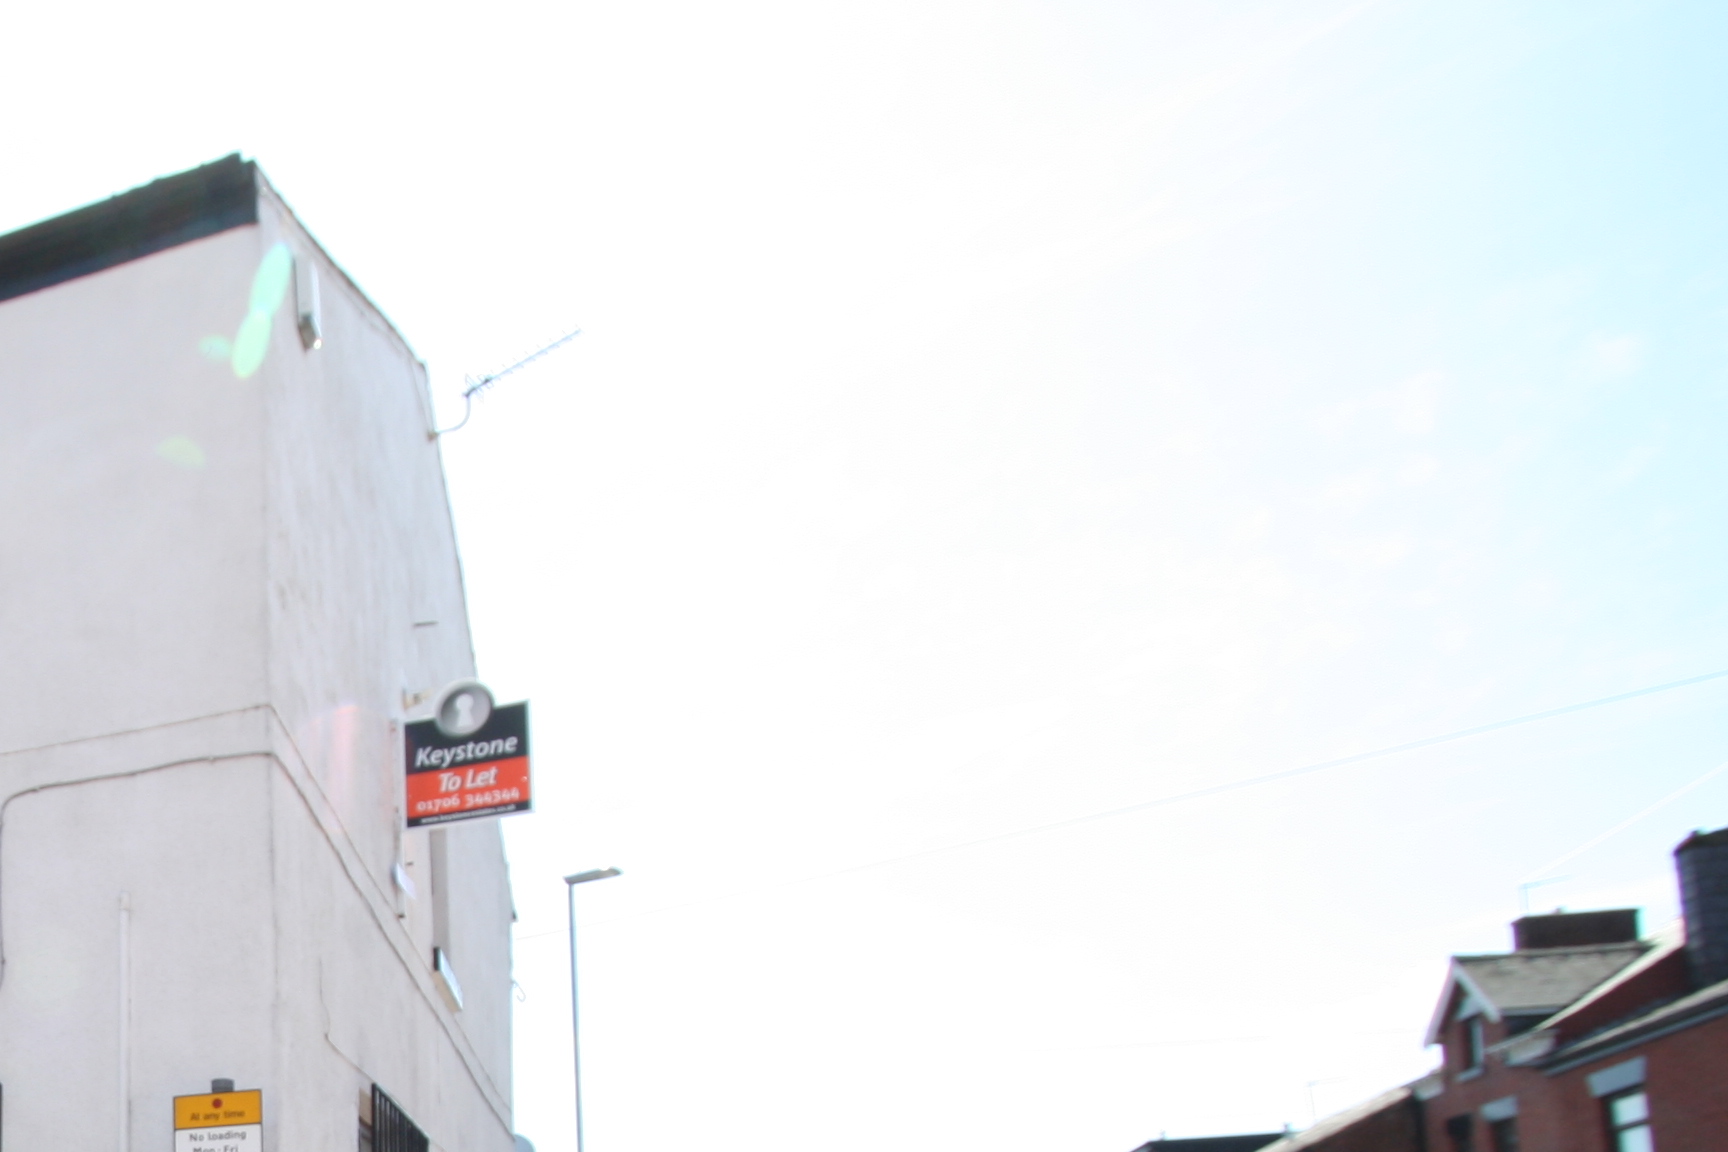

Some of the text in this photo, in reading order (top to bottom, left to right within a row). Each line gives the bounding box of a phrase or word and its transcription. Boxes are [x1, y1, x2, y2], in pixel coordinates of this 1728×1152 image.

[415, 735, 518, 768] Keystone
[439, 766, 498, 793] To Let
[415, 787, 520, 812] 01706 344344
[190, 1110, 246, 1121] At any time
[189, 1133, 204, 1141] No
